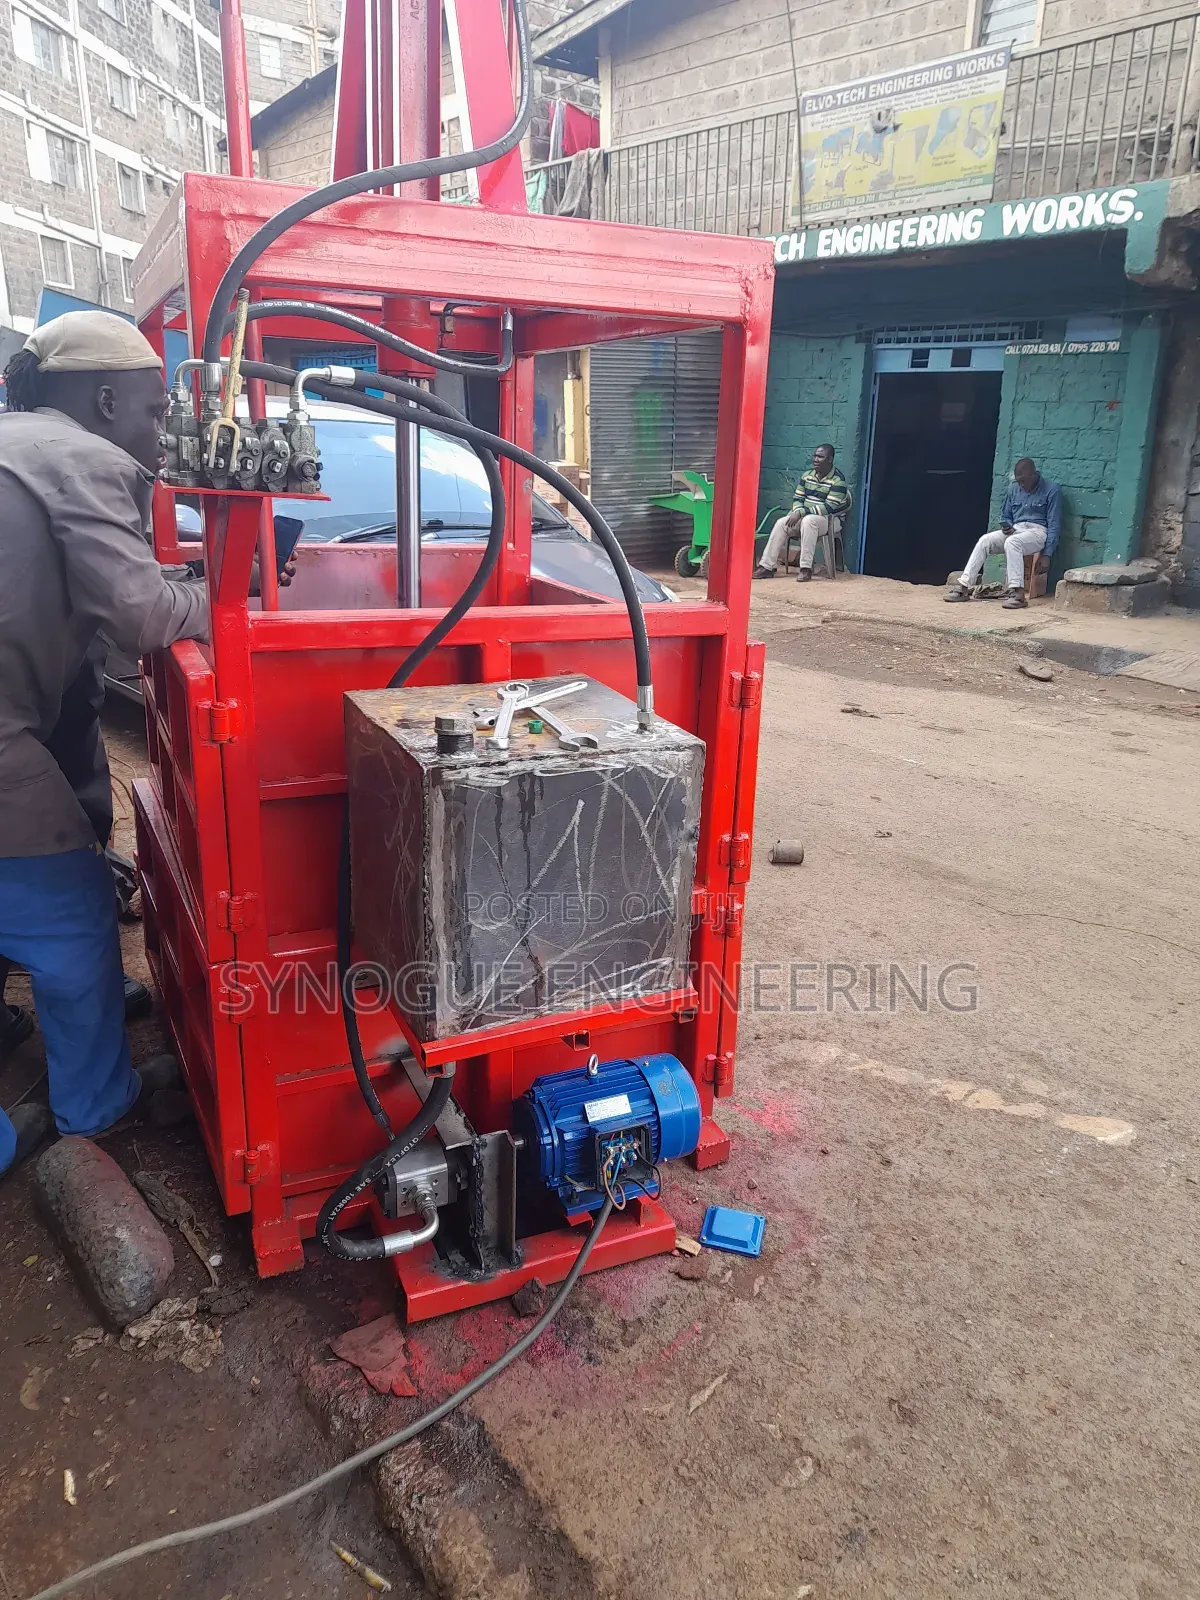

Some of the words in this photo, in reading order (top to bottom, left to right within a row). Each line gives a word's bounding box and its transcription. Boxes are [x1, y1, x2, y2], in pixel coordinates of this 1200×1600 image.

[805, 85, 866, 113] ELVO-TECH
[868, 67, 953, 98] ENGINEERING
[955, 51, 1006, 78] WORKS
[816, 207, 985, 257] ENGINEERING
[1002, 188, 1144, 236] WORKS.
[1089, 342, 1105, 352] 228
[1107, 342, 1120, 351] 701
[354, 1177, 372, 1193] SAE
